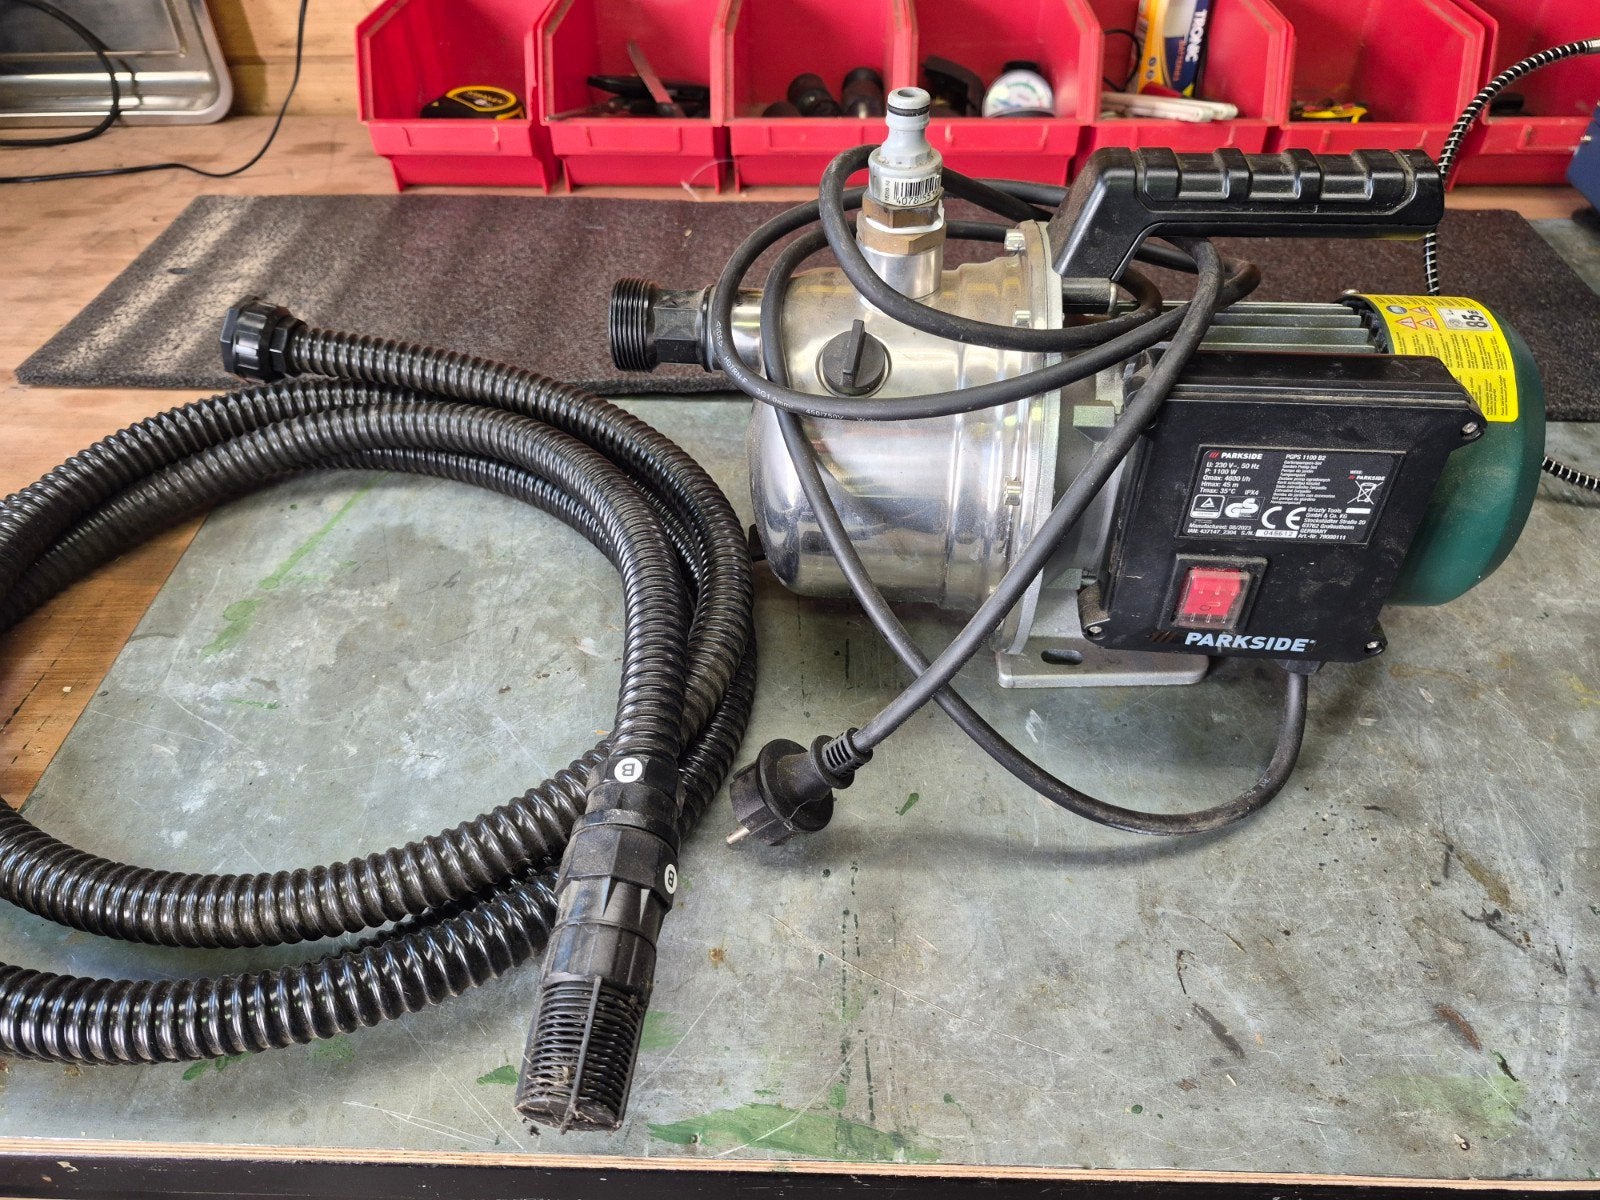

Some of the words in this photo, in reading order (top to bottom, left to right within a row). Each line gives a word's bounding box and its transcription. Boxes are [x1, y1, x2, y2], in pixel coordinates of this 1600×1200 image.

[1221, 452, 1263, 460] PARKSIDE
[1185, 632, 1309, 652] PARKSIDE
[621, 763, 636, 777] B
[667, 870, 675, 887] B
